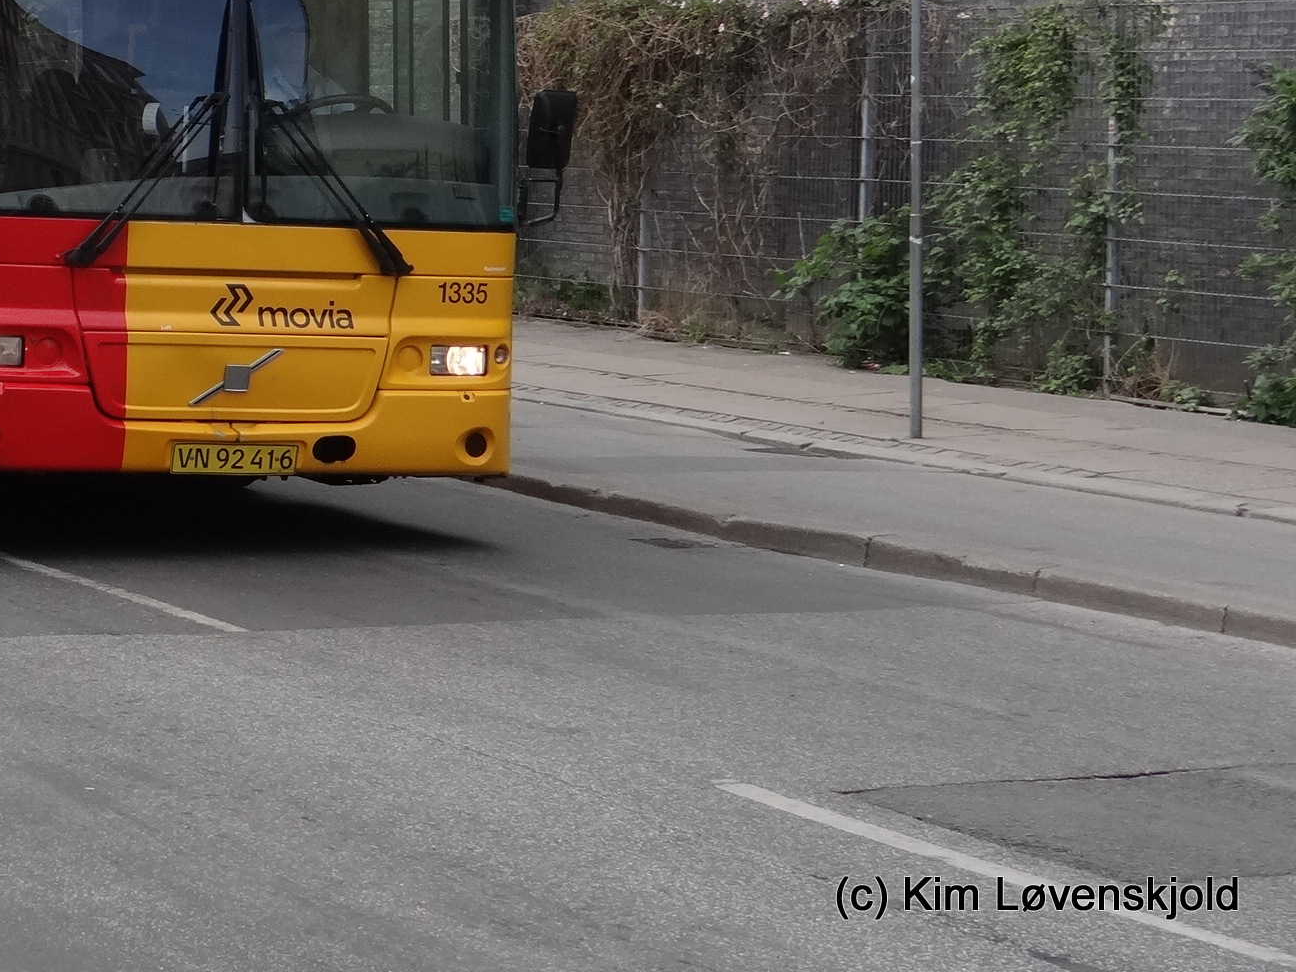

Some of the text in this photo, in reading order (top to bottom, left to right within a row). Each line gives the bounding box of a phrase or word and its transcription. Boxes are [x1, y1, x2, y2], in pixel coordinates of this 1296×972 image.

[438, 281, 489, 305] 1335
[257, 300, 355, 330] movia
[178, 447, 294, 470] VN 92 416
